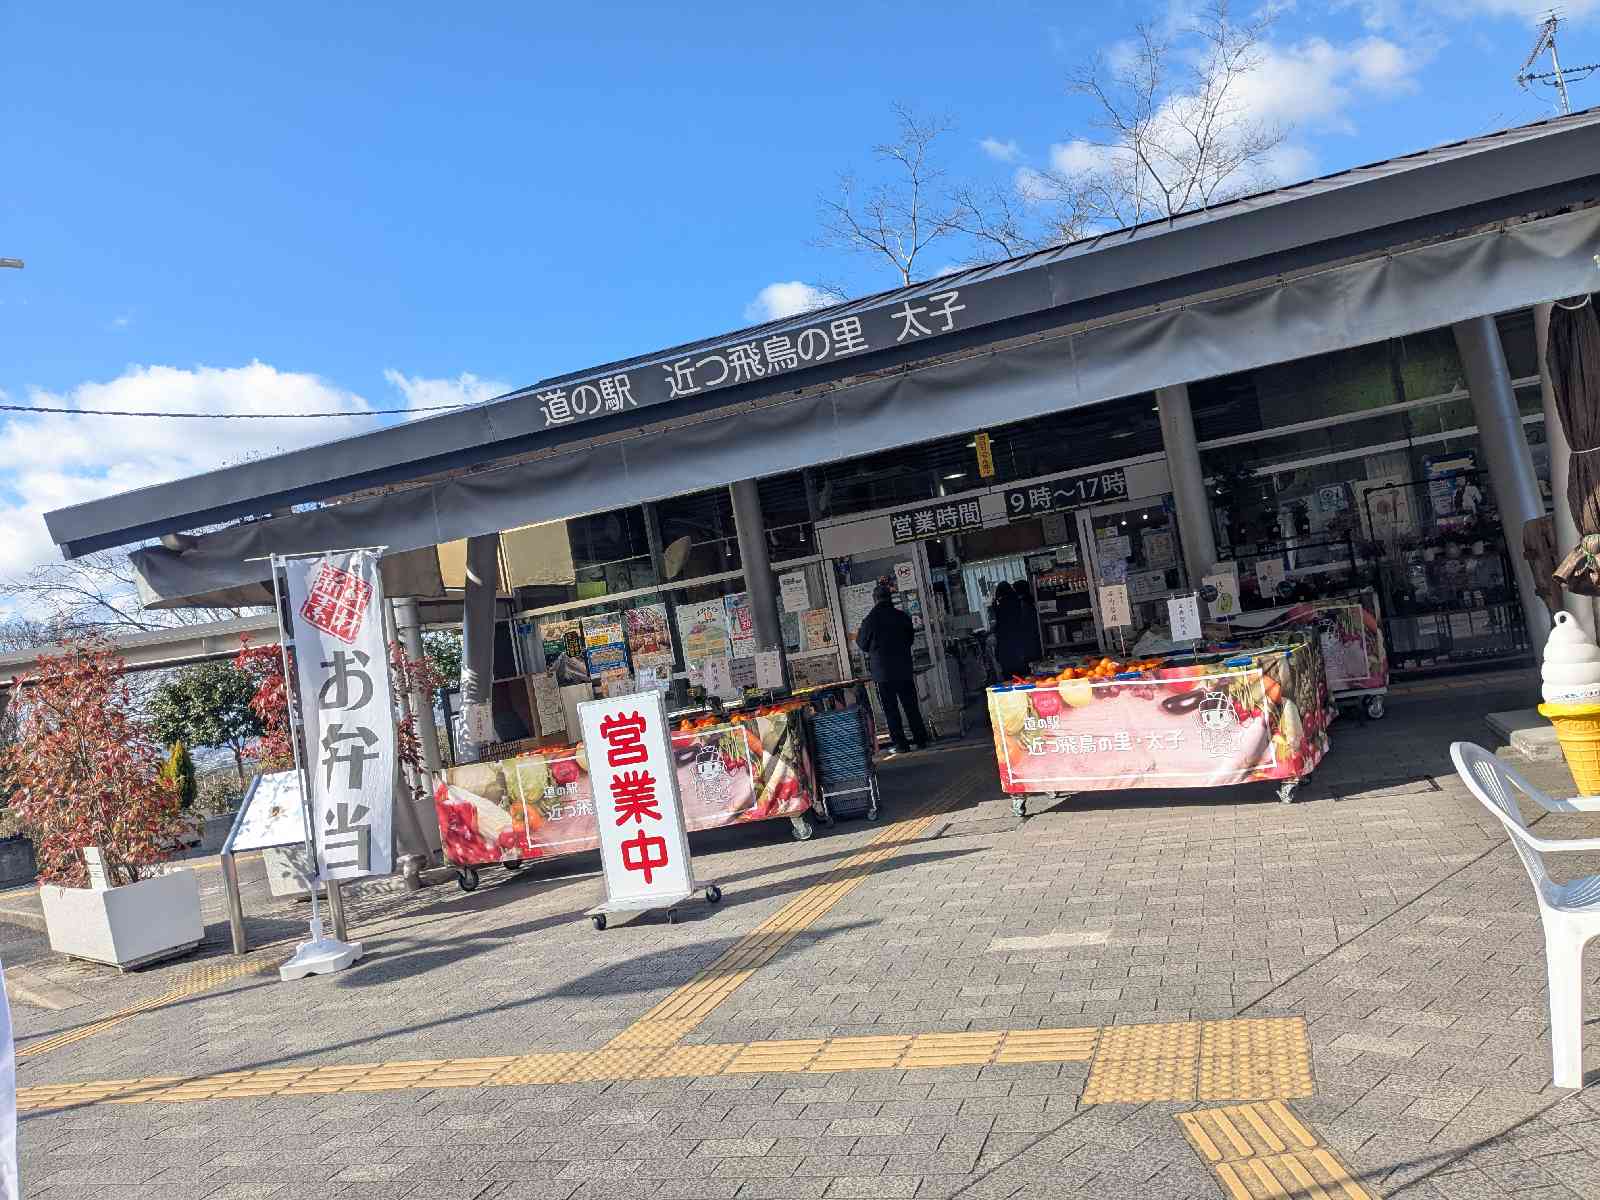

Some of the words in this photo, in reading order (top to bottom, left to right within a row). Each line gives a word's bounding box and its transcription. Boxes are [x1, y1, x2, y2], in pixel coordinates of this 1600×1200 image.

[537, 373, 637, 427] 道の駅
[663, 315, 869, 400] 近つ飛鳥の里
[890, 290, 967, 343] 太子
[891, 502, 981, 540] 営業時間
[318, 649, 380, 872] お弁当
[1023, 715, 1061, 731] 道の駅
[600, 710, 669, 885] 営業中
